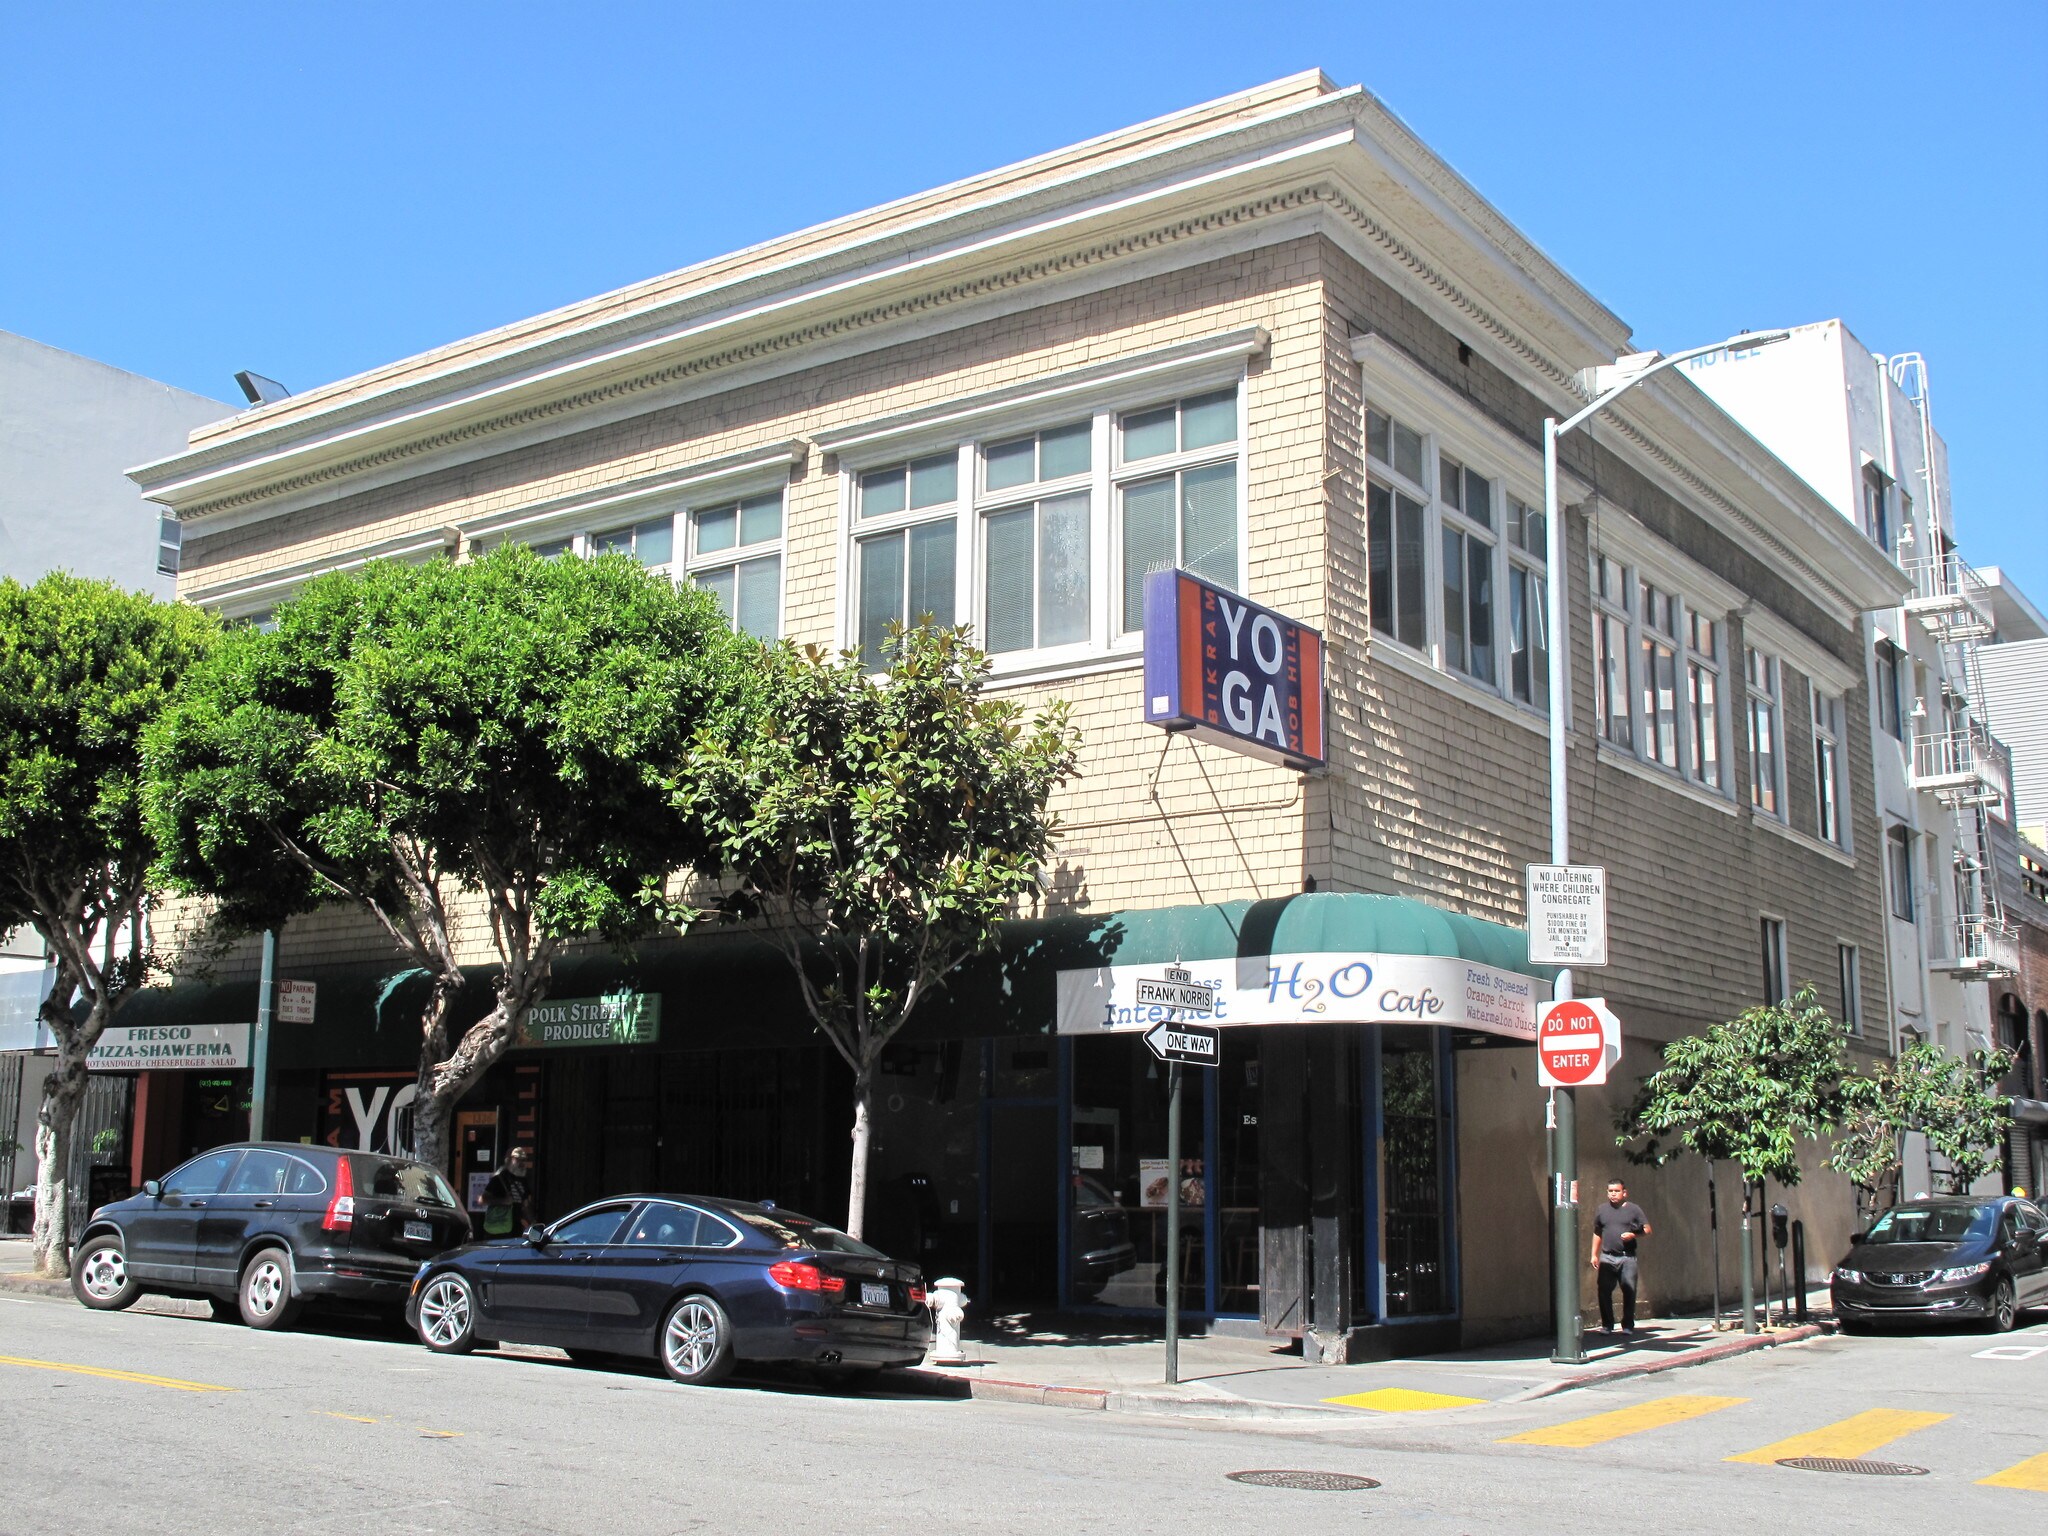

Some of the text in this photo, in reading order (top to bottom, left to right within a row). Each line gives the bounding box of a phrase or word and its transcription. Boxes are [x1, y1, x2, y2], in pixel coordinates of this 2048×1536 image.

[1218, 596, 1283, 675] YO
[1205, 589, 1218, 724] BIKRAM
[1287, 627, 1298, 752] NOB HILL
[1222, 670, 1287, 748] GA
[1540, 872, 1592, 883] NO LOITERING
[1533, 883, 1600, 894] WHERE CHILDREN
[1542, 894, 1591, 905] CONGREGATE
[1170, 970, 1189, 981] END
[1467, 969, 1528, 996] Fresh Squeezed
[281, 981, 314, 993] NO PARKING
[1141, 985, 1210, 1007] FRANK NORRIS
[1266, 962, 1373, 1013] H2O
[1466, 987, 1525, 1013] Orange Carrot
[528, 1006, 567, 1025] POLK
[570, 1001, 628, 1022] STREET
[1466, 1006, 1536, 1032] Watermelon Juice
[543, 1023, 610, 1041] PRODUCE
[1548, 1016, 1594, 1032] DO NOT
[128, 1027, 191, 1041] FRESCO
[1167, 1033, 1211, 1053] ONE WAY
[89, 1043, 232, 1058] PIZZA-SHAWERMA
[101, 1060, 140, 1068] SANDWICH
[146, 1059, 206, 1067] CHEESEBURGER
[211, 1058, 236, 1066] SALAD
[1553, 1054, 1590, 1068] ENTER
